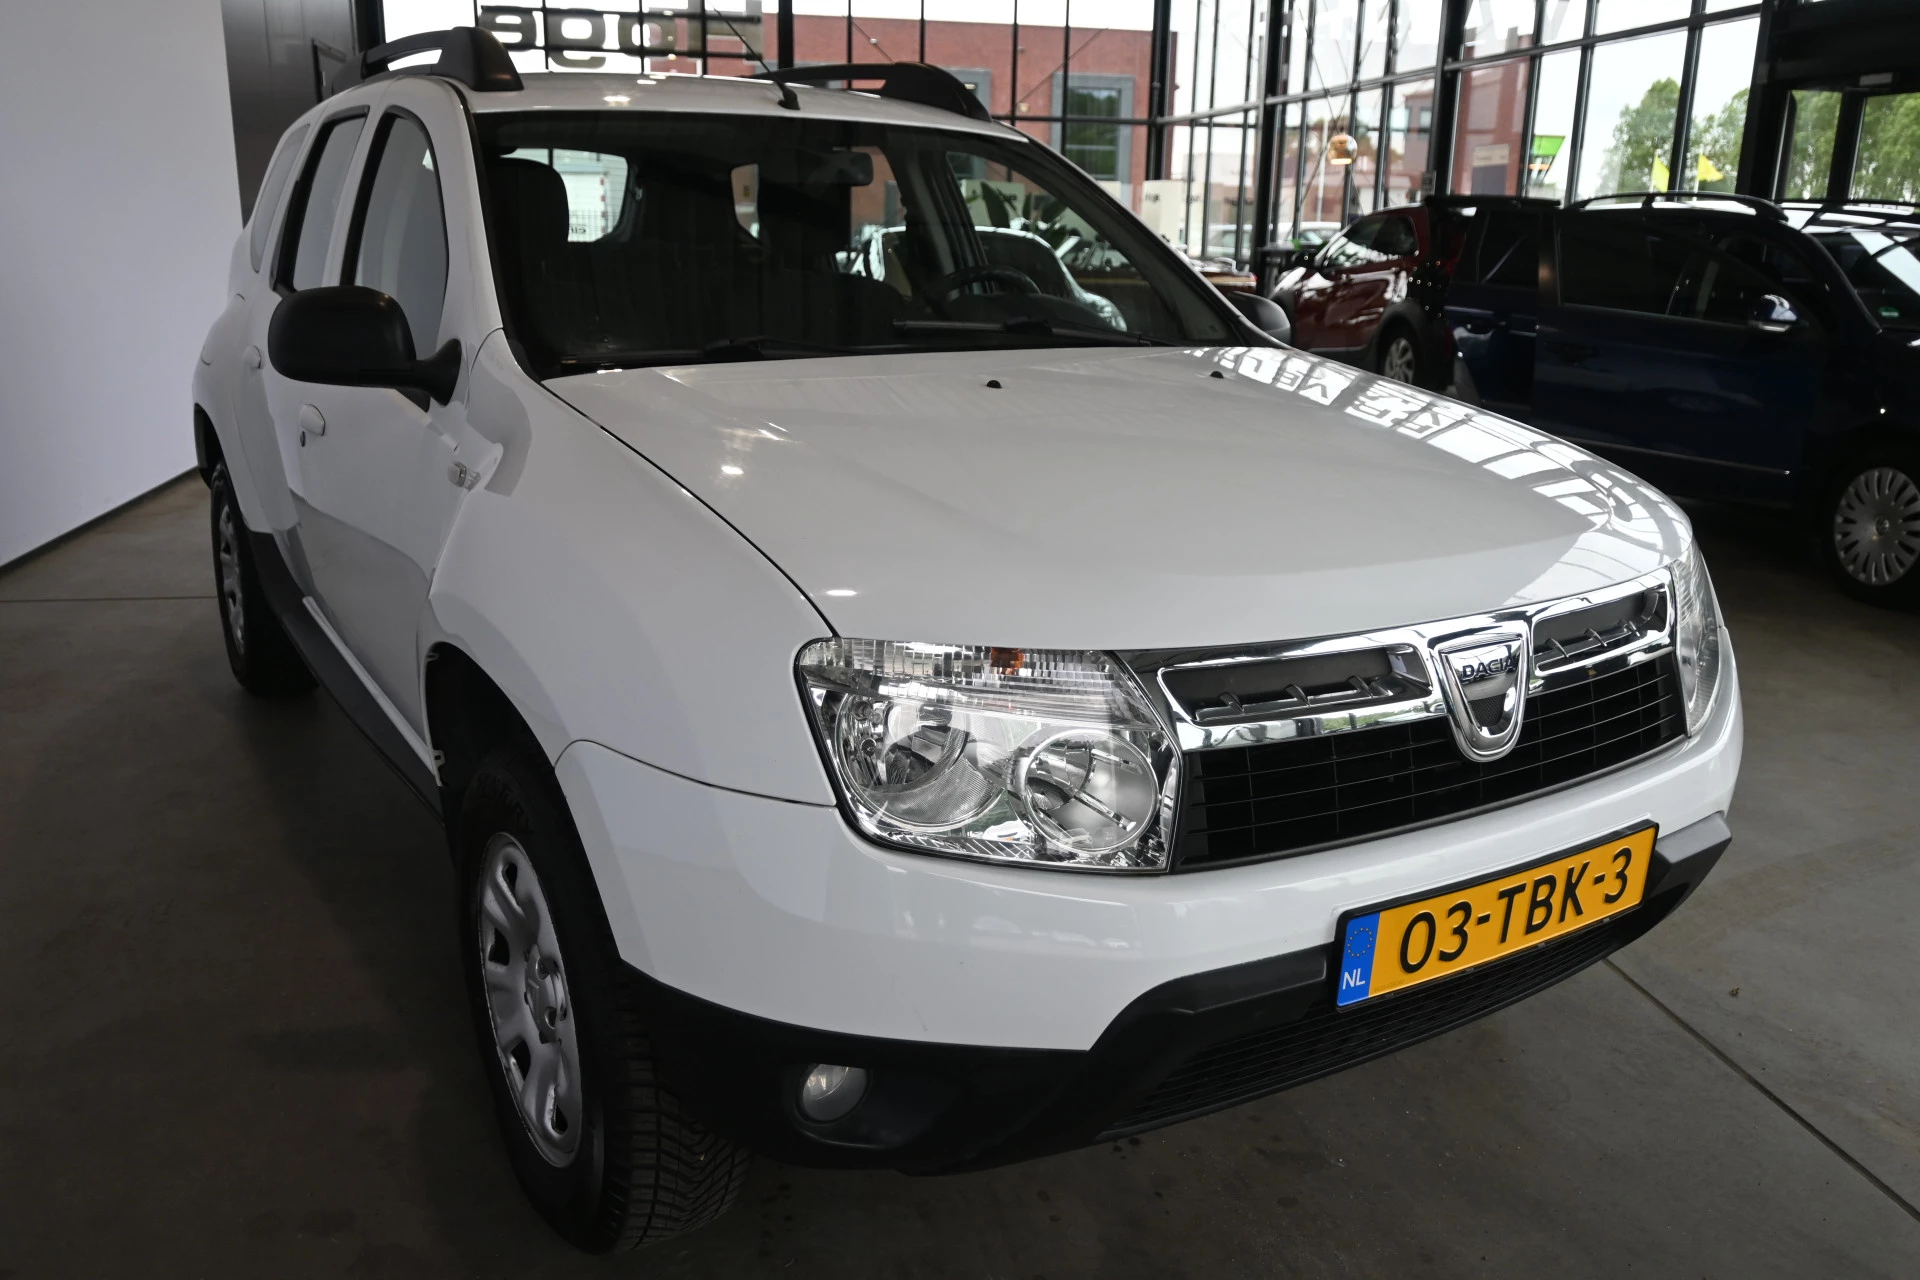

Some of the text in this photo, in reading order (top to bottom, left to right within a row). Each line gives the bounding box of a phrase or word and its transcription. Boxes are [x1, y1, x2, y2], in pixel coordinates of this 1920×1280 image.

[1462, 657, 1517, 680] DACIA
[1400, 847, 1632, 974] 03-TBK-3
[1342, 967, 1366, 990] NL
